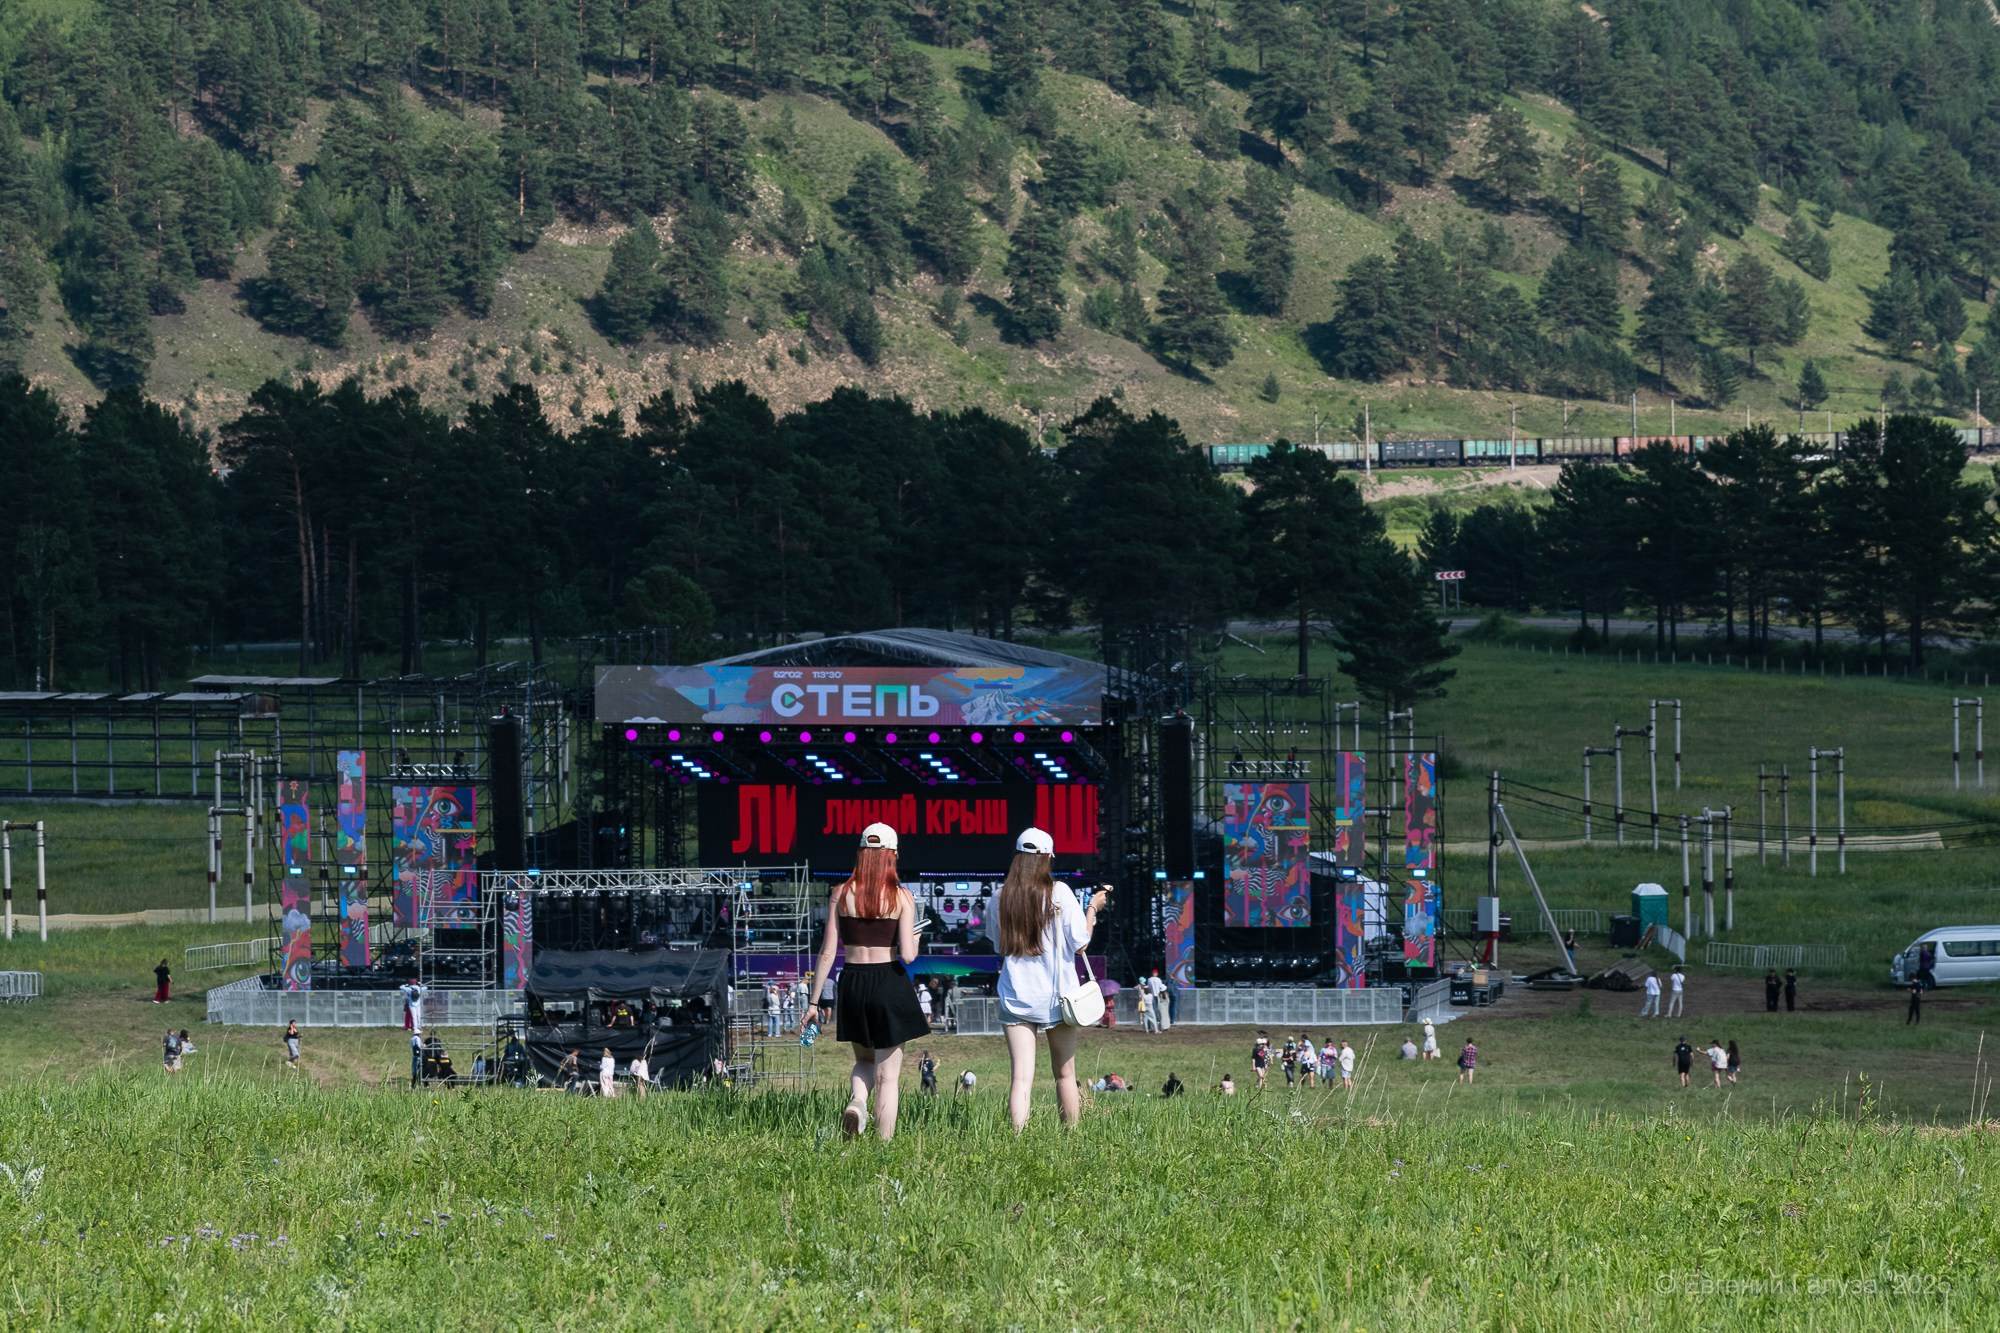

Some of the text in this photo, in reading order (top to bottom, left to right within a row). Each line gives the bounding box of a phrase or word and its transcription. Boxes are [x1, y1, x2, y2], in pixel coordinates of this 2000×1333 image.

[771, 683, 939, 717] СТЕПЬ
[822, 793, 1008, 835] ЛИНИЙ КРЫШ
